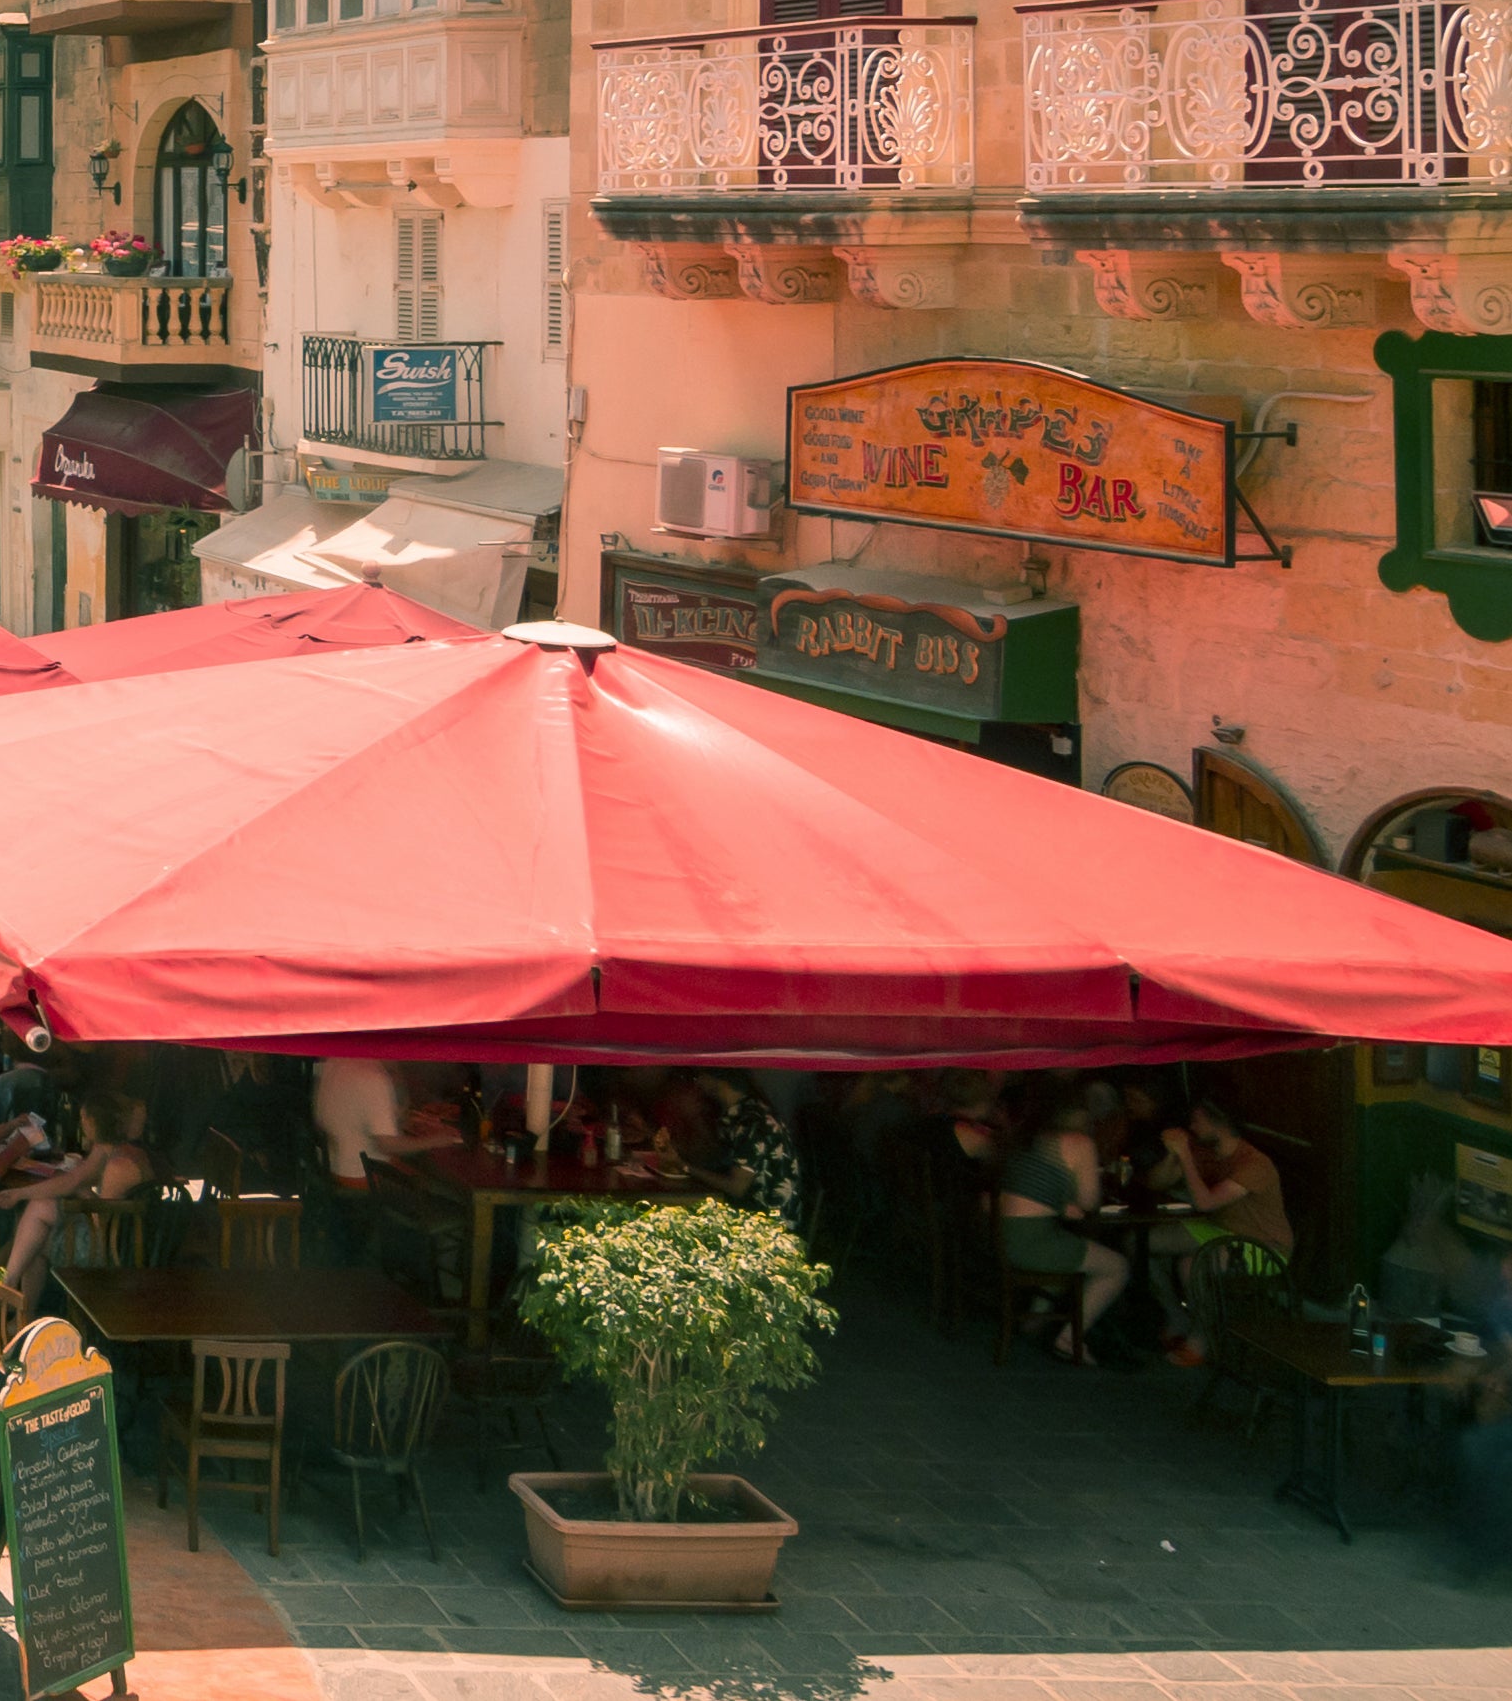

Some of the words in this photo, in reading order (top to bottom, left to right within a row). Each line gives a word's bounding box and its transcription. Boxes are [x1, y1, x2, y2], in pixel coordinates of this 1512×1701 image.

[376, 352, 452, 380] Swish
[805, 406, 837, 421] GOOD
[839, 408, 864, 424] WINE
[915, 387, 1113, 466] GRAPES
[821, 453, 838, 464] AND
[314, 476, 340, 489] THE
[863, 440, 949, 488] WINE
[1051, 463, 1146, 522] BAR
[796, 612, 905, 670] RABBIT
[914, 633, 980, 685] BISS
[41, 1407, 64, 1428] TASTE
